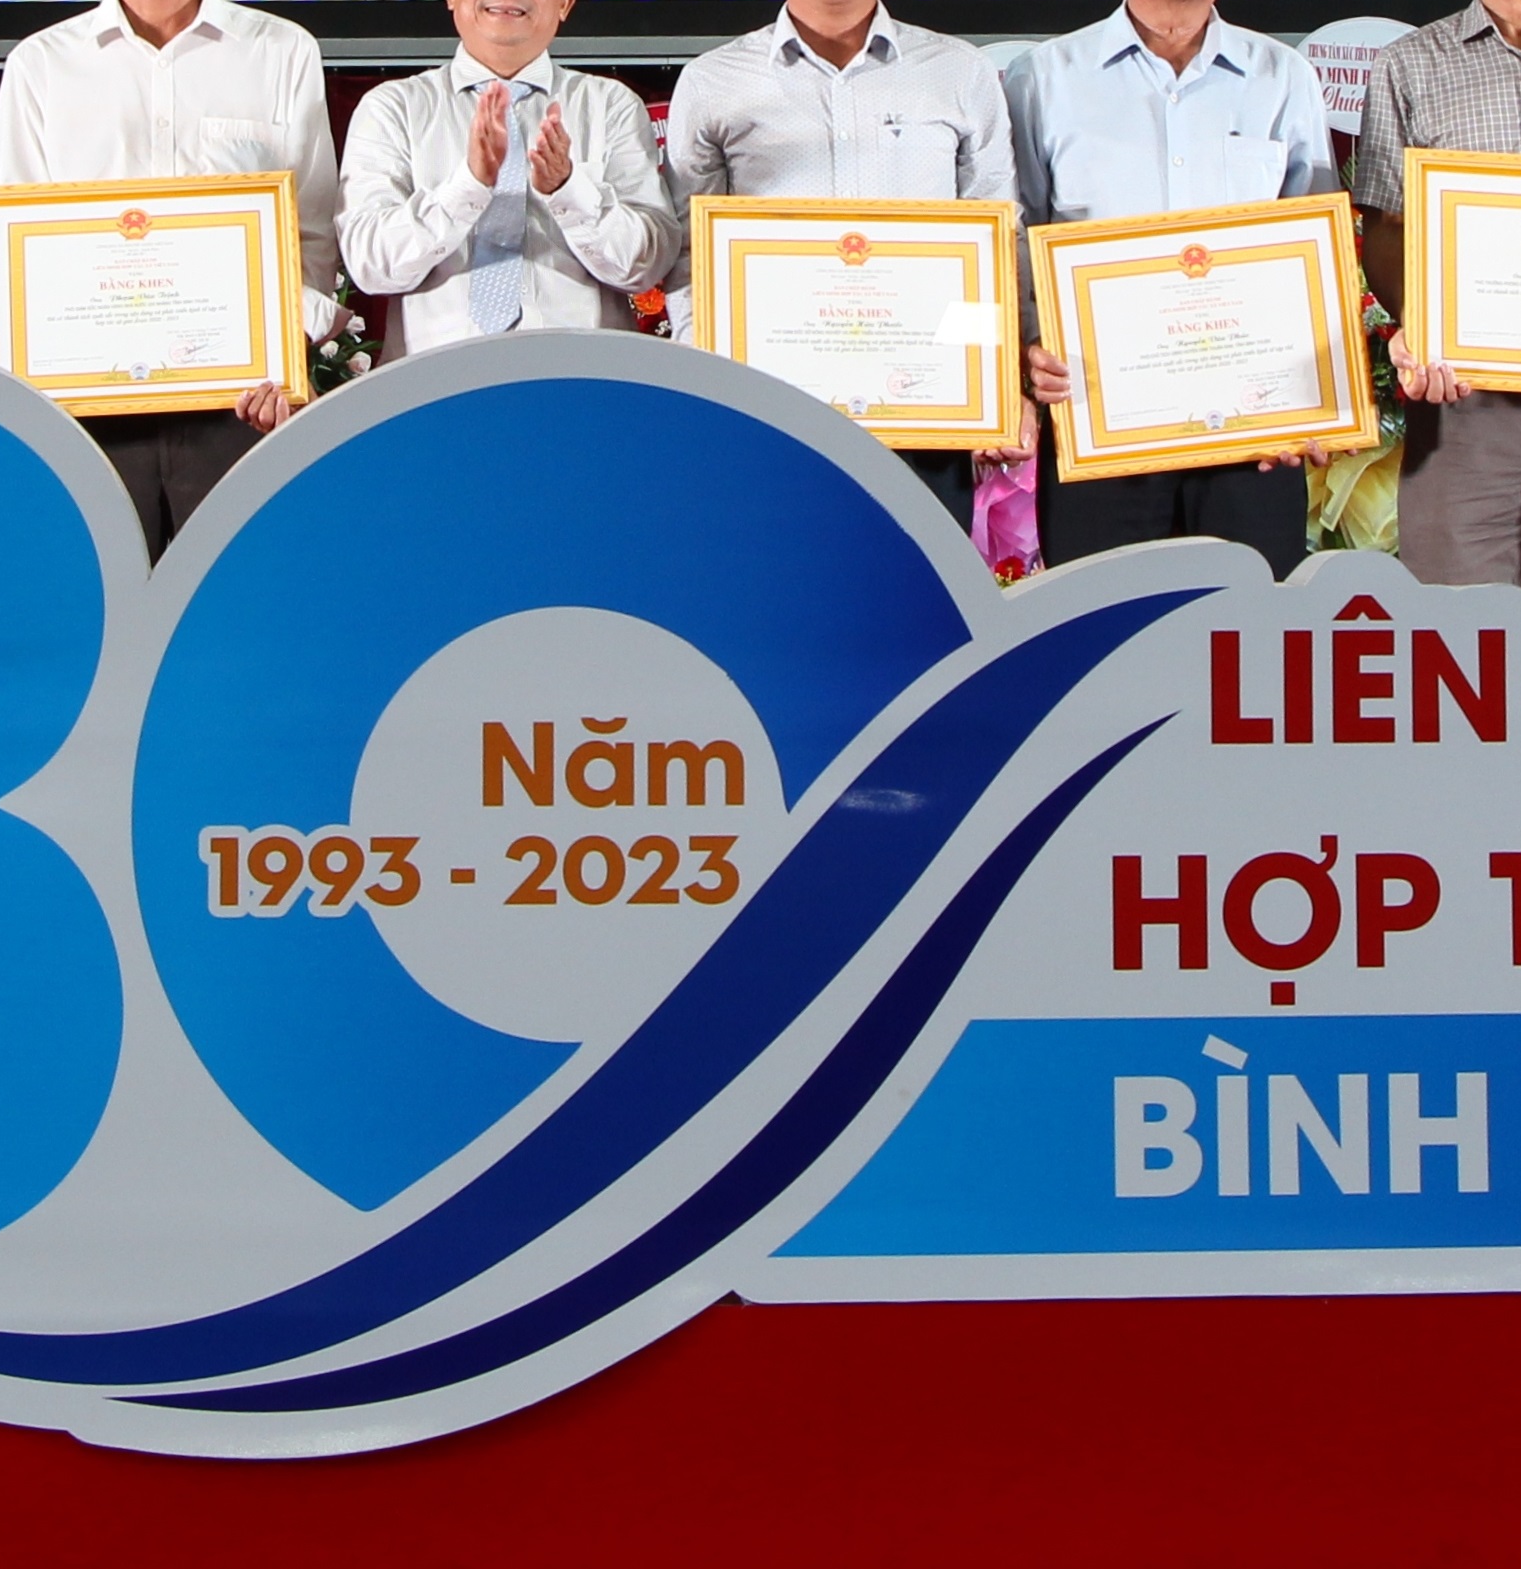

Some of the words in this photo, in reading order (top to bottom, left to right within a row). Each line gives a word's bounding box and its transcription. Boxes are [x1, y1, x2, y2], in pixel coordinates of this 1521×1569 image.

[1327, 68, 1358, 84] MINH
[100, 277, 134, 290] BẰNG
[138, 278, 174, 288] KHEN
[819, 305, 854, 318] BẰNG
[857, 308, 893, 318] KHEN
[1168, 320, 1201, 335] BẰNG
[1205, 318, 1240, 331] KHEN
[1209, 595, 1507, 744] LIÊN
[481, 717, 745, 809] Năm
[210, 836, 421, 906] 1993
[450, 868, 476, 883] -
[503, 836, 740, 906] 2023
[1112, 834, 1441, 1006] HỢP
[1113, 1033, 1490, 1199] BÌNH
